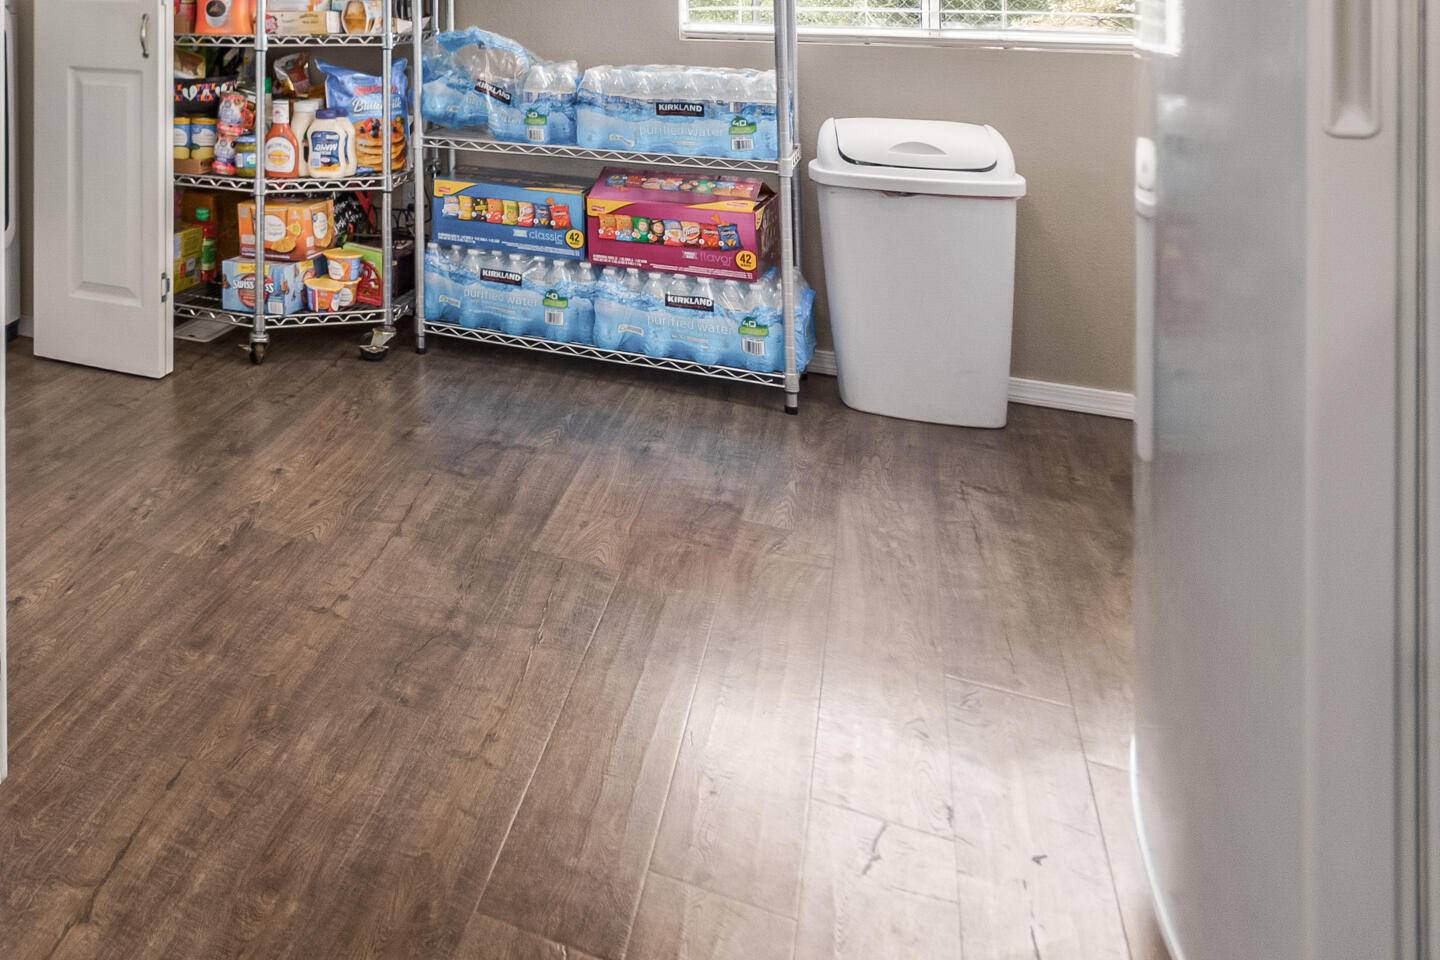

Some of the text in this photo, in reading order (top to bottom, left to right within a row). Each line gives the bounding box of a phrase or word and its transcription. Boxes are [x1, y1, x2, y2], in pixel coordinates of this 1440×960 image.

[476, 81, 511, 100] KIRKLAND
[658, 103, 703, 112] KIRKLAND
[528, 230, 563, 241] classic
[569, 232, 580, 242] 42
[700, 251, 733, 264] flavor
[740, 254, 752, 265] 42
[482, 269, 521, 281] KIRKLAND
[233, 279, 255, 289] SWISS
[667, 295, 713, 306] KIRKLAND
[742, 320, 757, 328] 40
